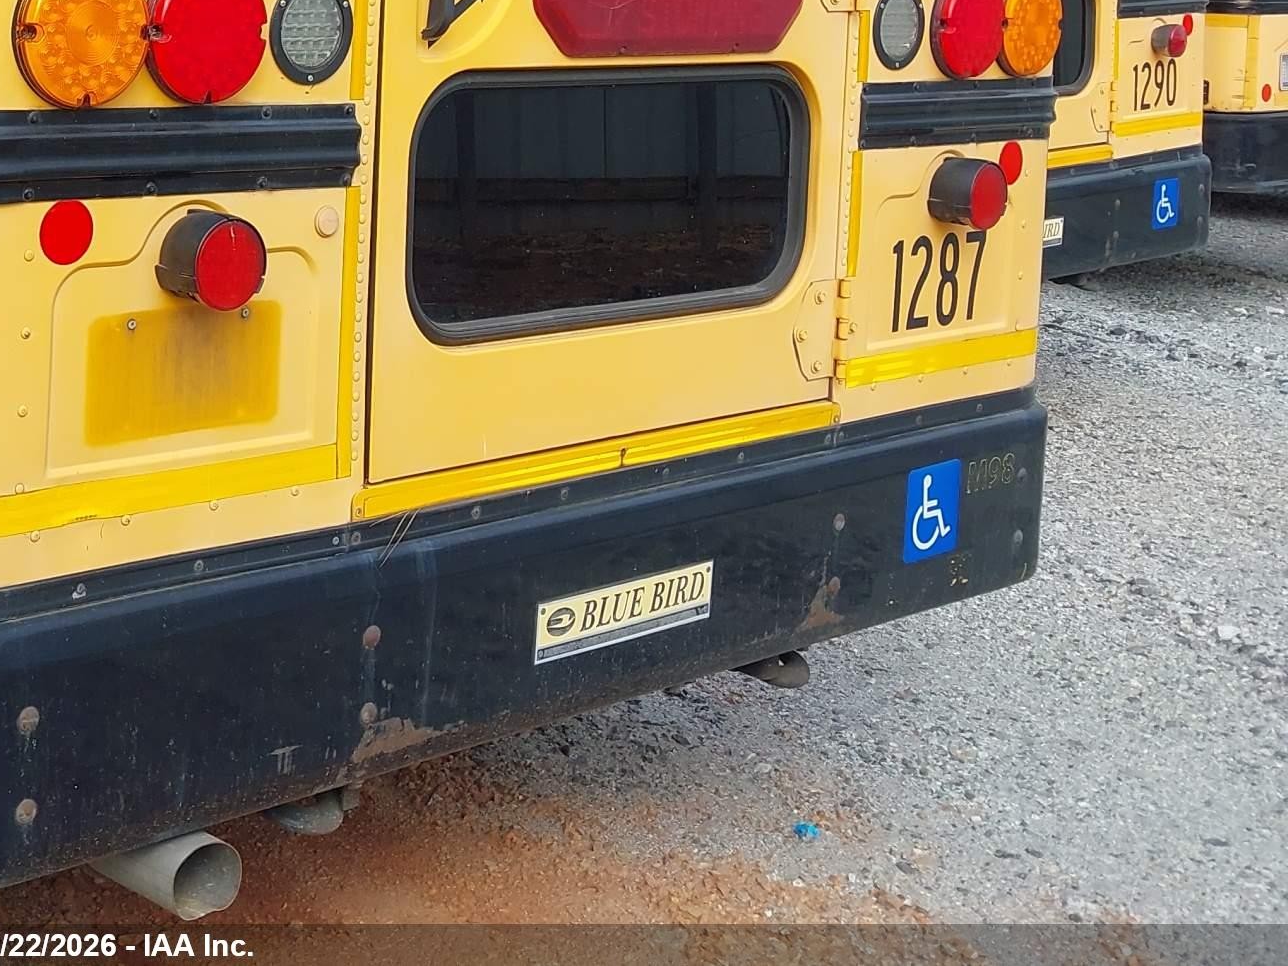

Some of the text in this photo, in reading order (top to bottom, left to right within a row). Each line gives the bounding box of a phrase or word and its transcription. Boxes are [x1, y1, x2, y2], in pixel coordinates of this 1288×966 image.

[1132, 58, 1178, 112] 1290
[1042, 222, 1061, 239] IRD
[891, 229, 988, 333] 1287
[580, 571, 705, 632] BLUE BIRD
